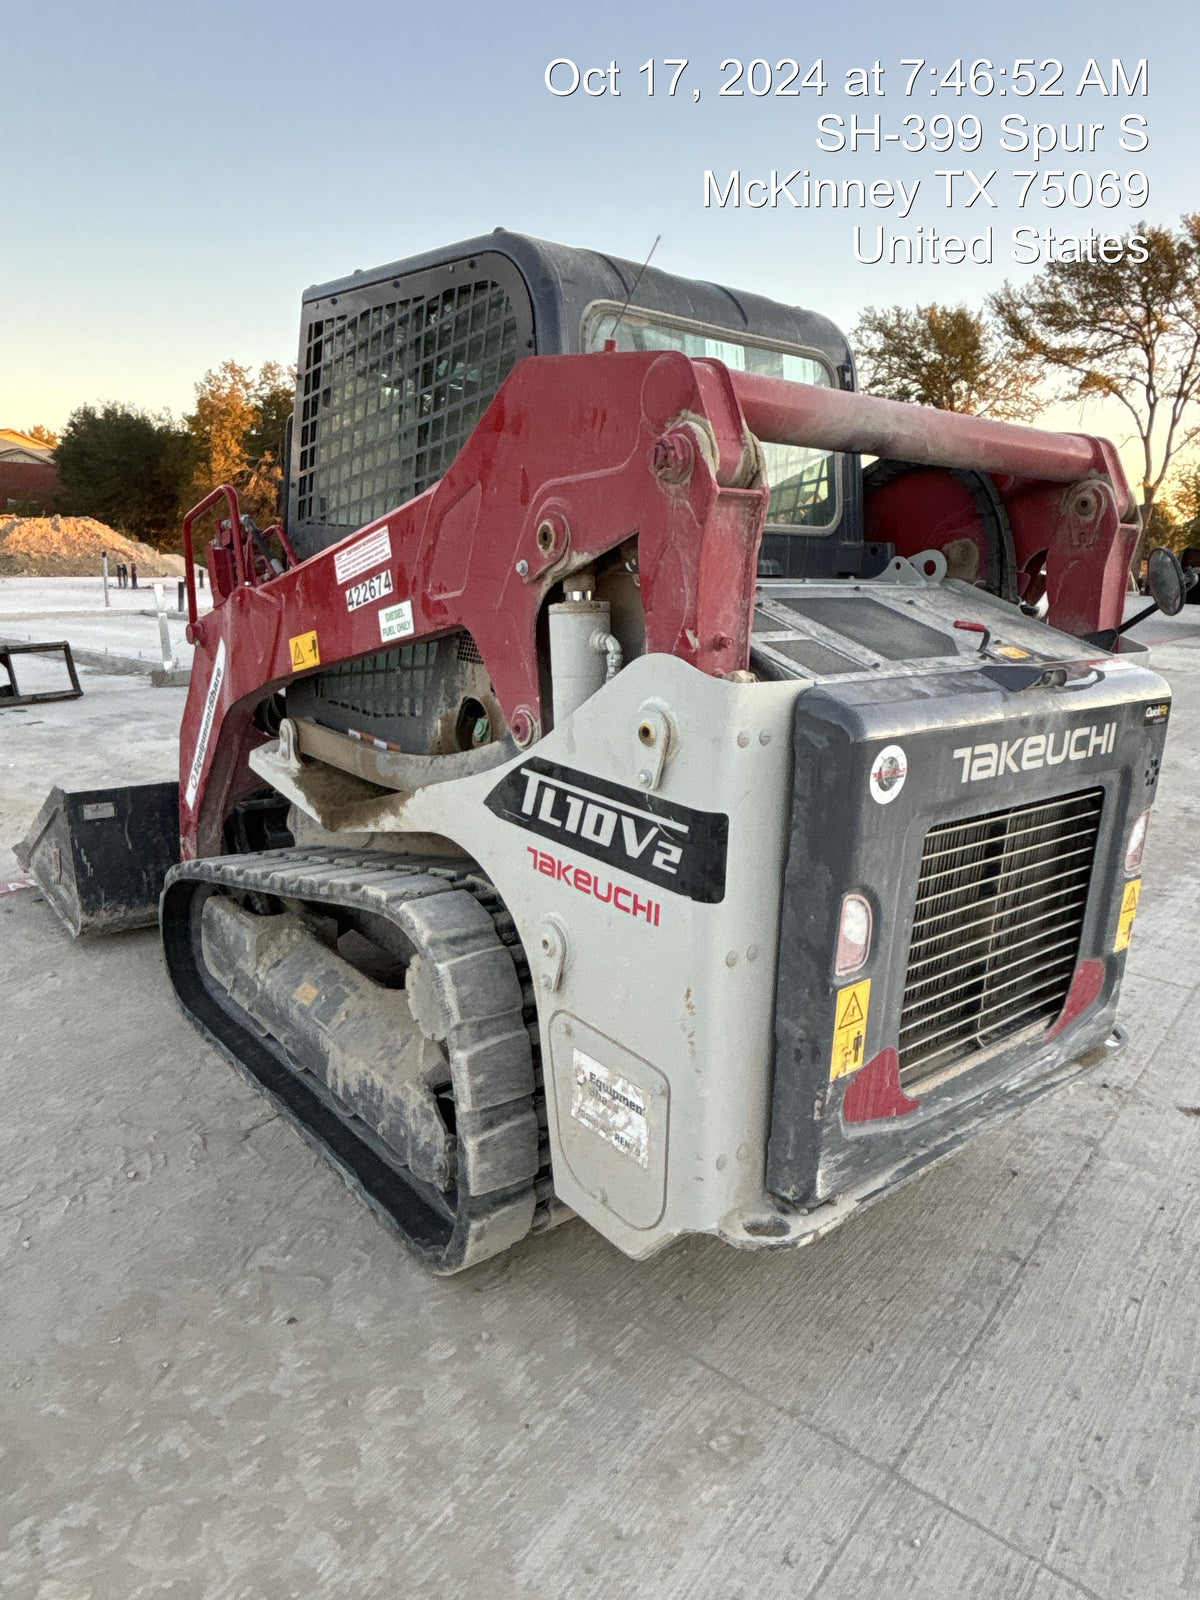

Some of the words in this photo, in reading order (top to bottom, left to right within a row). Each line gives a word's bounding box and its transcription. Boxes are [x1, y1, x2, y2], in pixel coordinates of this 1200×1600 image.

[347, 570, 392, 609] 422674
[385, 608, 405, 622] DIESEL
[382, 625, 396, 637] FUEL
[396, 620, 411, 633] ONLY
